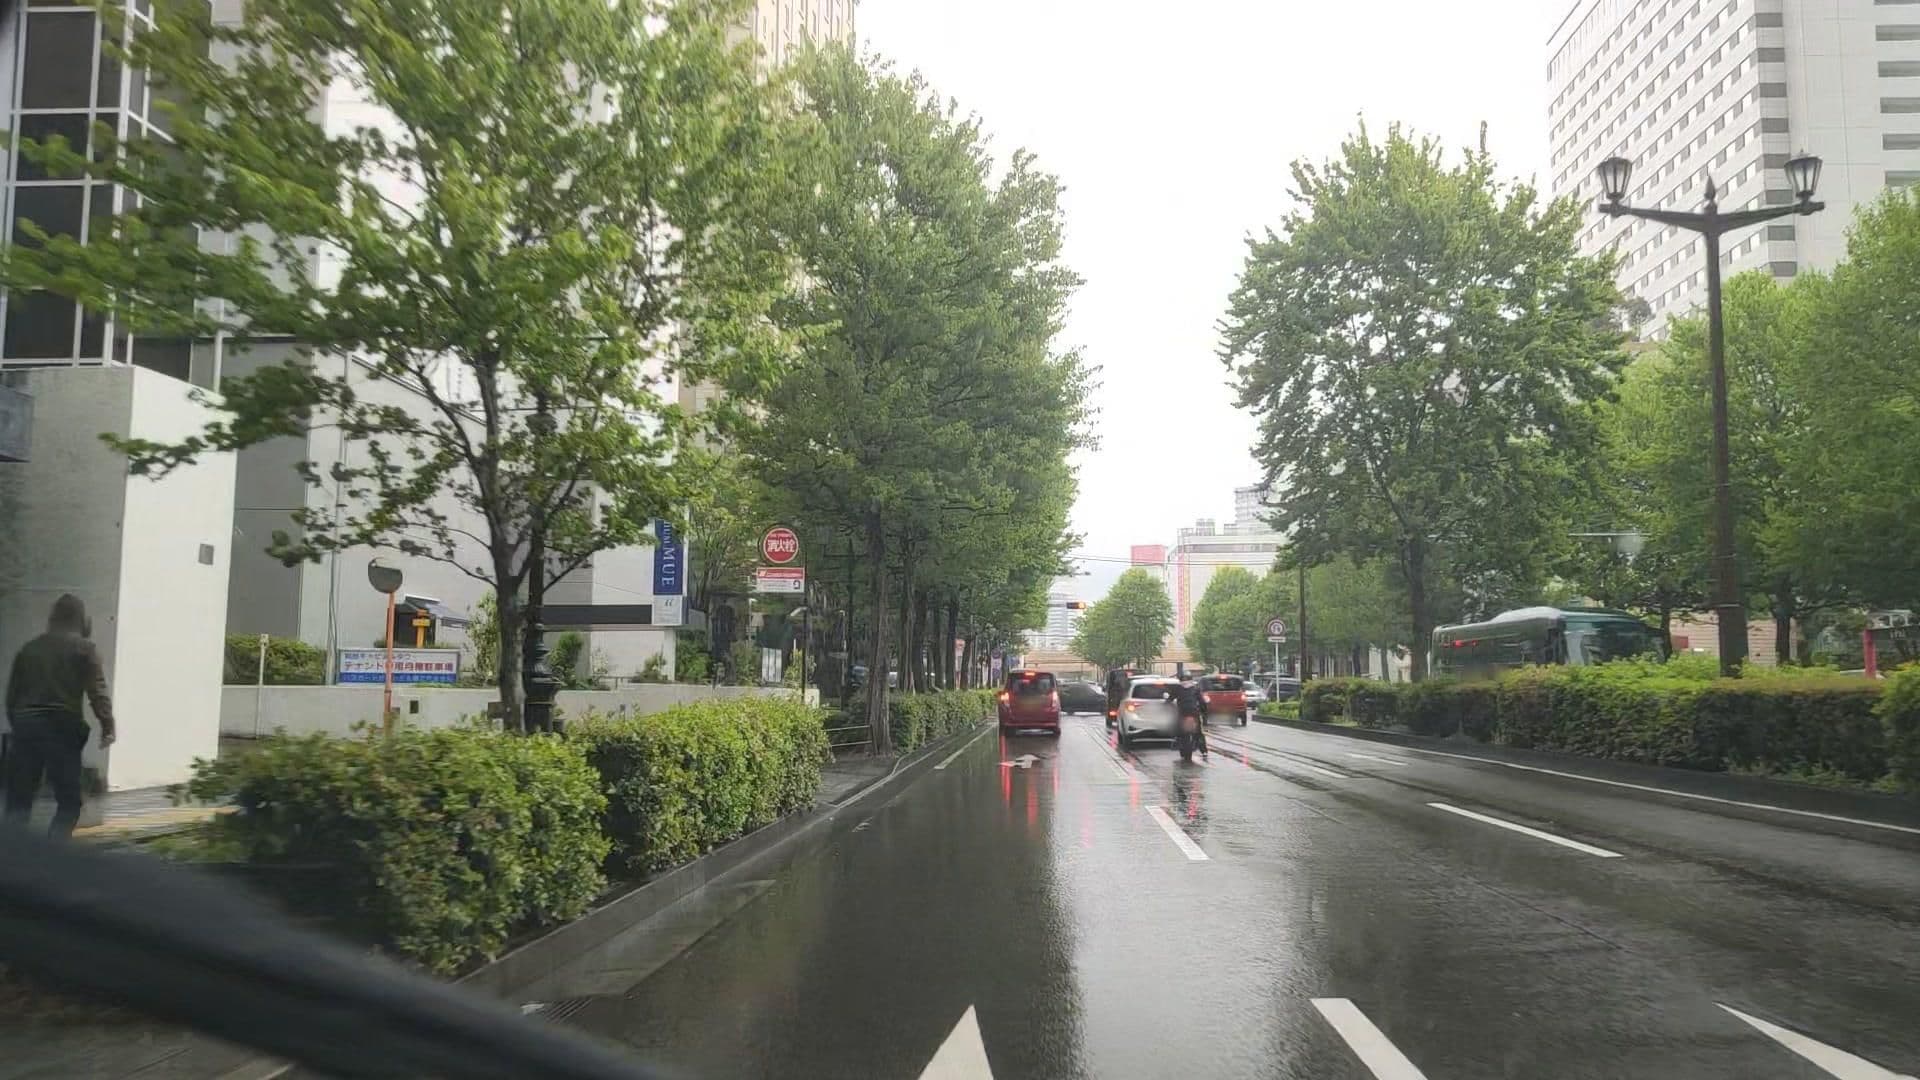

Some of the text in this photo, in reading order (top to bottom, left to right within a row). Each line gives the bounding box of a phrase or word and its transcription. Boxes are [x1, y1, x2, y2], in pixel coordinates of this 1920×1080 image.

[767, 539, 795, 553] 消火栓
[662, 547, 675, 586] MUE
[345, 662, 453, 671] テナント用月極駐車場
